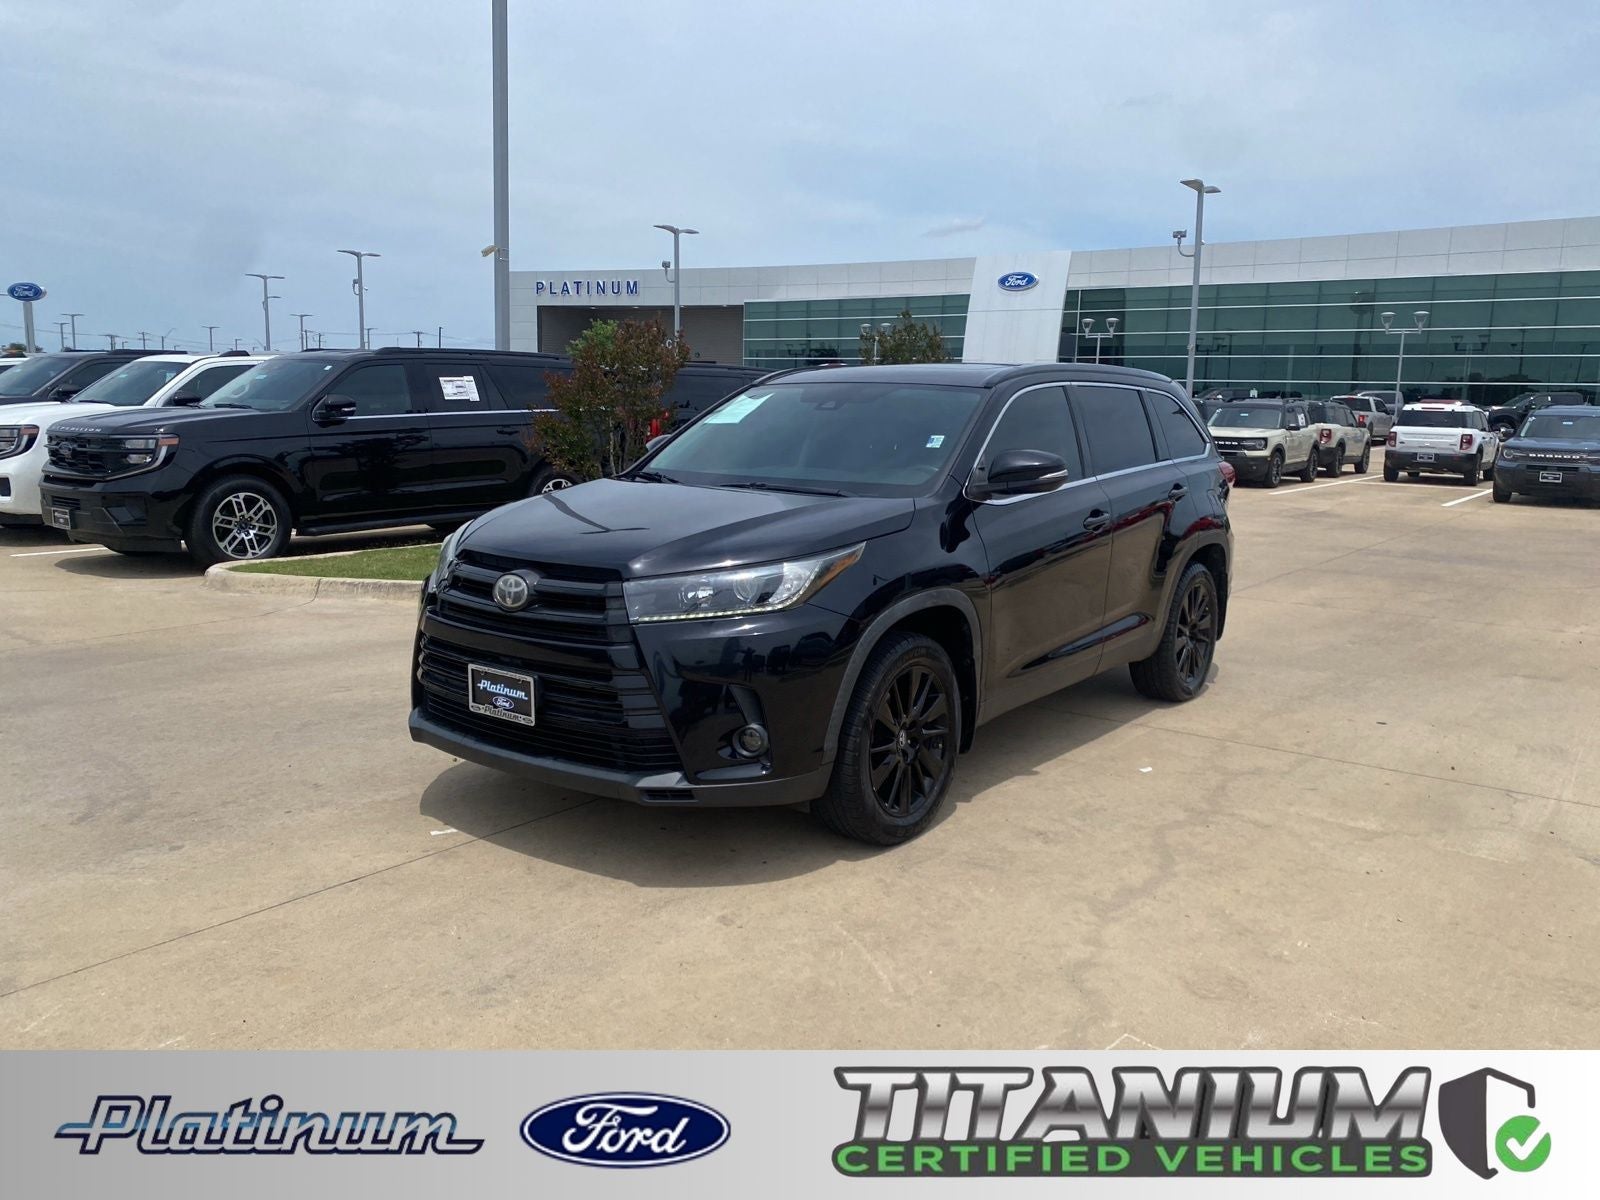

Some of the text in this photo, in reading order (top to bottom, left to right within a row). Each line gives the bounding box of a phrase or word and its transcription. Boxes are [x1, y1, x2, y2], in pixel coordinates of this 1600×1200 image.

[535, 280, 639, 295] PLATINUM
[1005, 275, 1028, 286] Ford
[477, 680, 528, 700] Platinum
[484, 705, 520, 721] Platinum
